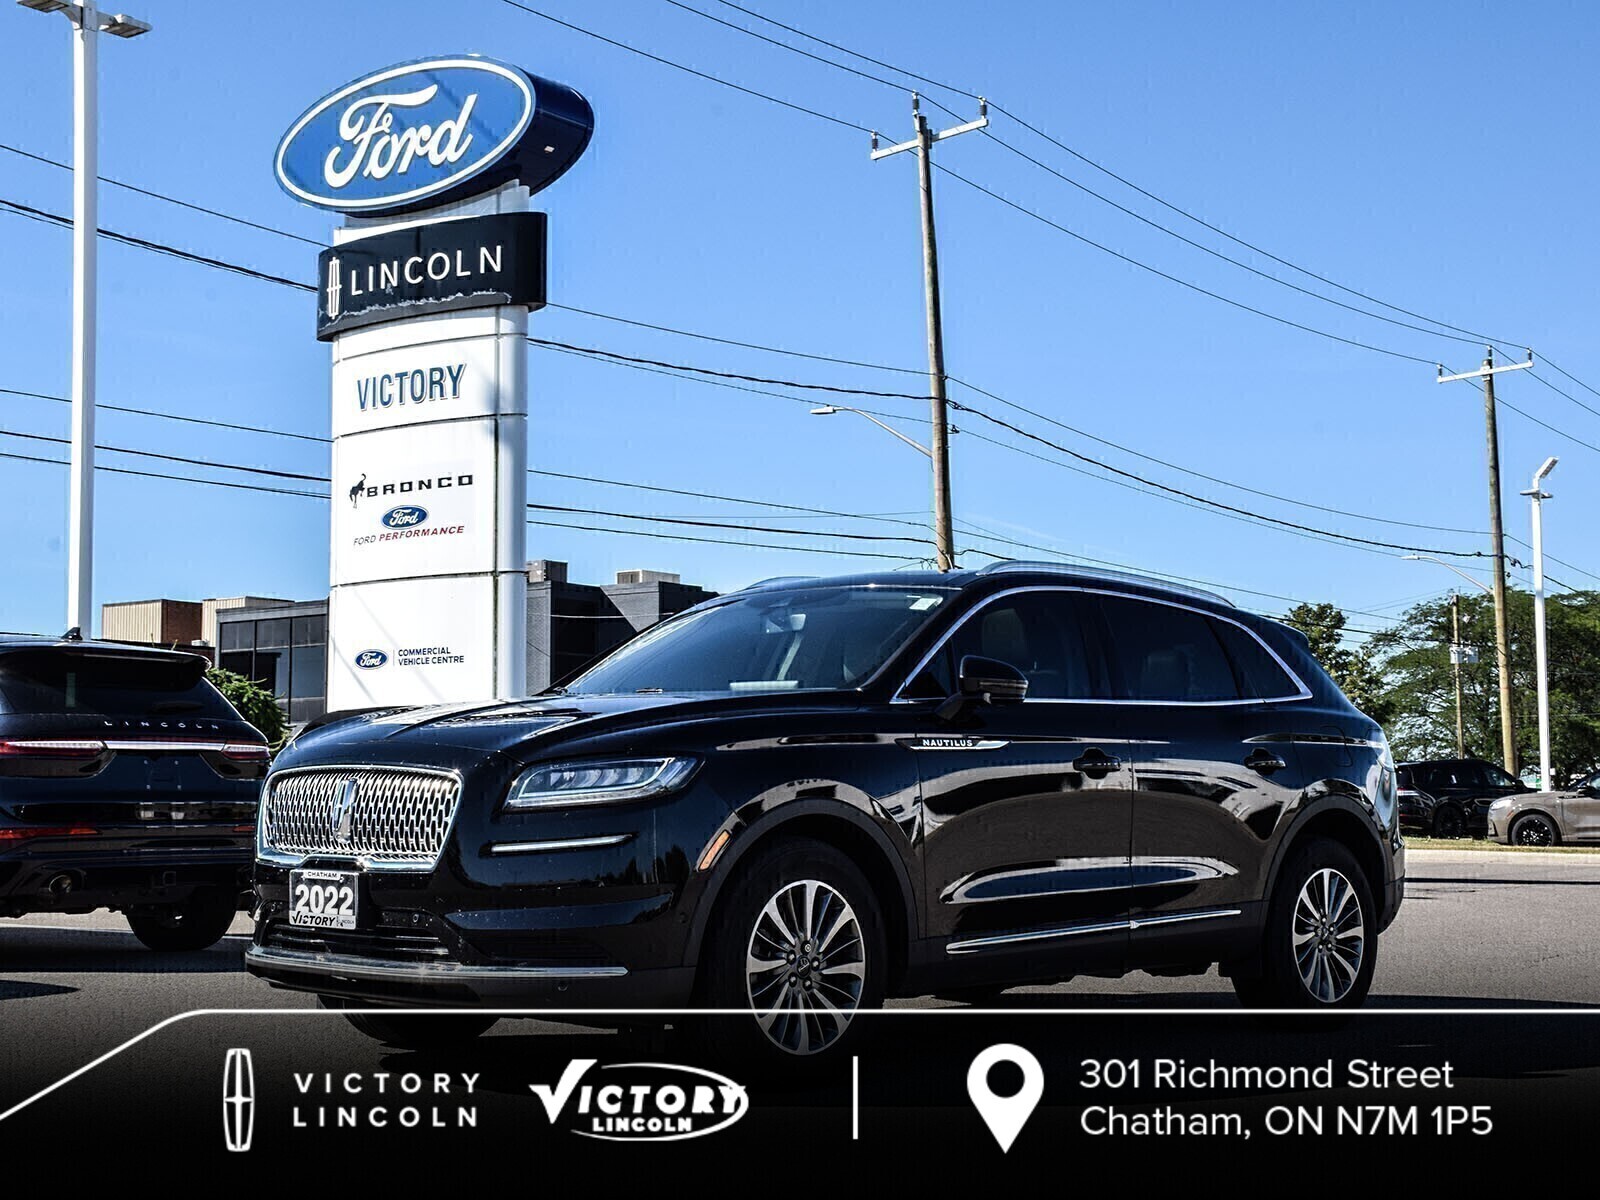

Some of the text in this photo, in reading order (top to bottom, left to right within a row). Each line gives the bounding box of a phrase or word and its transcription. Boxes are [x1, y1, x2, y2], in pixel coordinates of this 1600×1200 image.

[324, 84, 478, 188] Ford
[350, 245, 502, 295] LINCOLN
[357, 362, 467, 412] VICTORY
[366, 475, 473, 497] BRONCO
[389, 508, 419, 526] Ford
[353, 525, 465, 546] FORD PERFORMANCE
[360, 652, 382, 667] Ford
[398, 647, 451, 657] COMMERCIAL
[398, 655, 465, 666] VEHICLE CENTRE
[104, 720, 219, 730] LINCOLN
[922, 739, 973, 747] NAUTILUS
[295, 884, 354, 916] 2022
[292, 911, 335, 926] VICTORY
